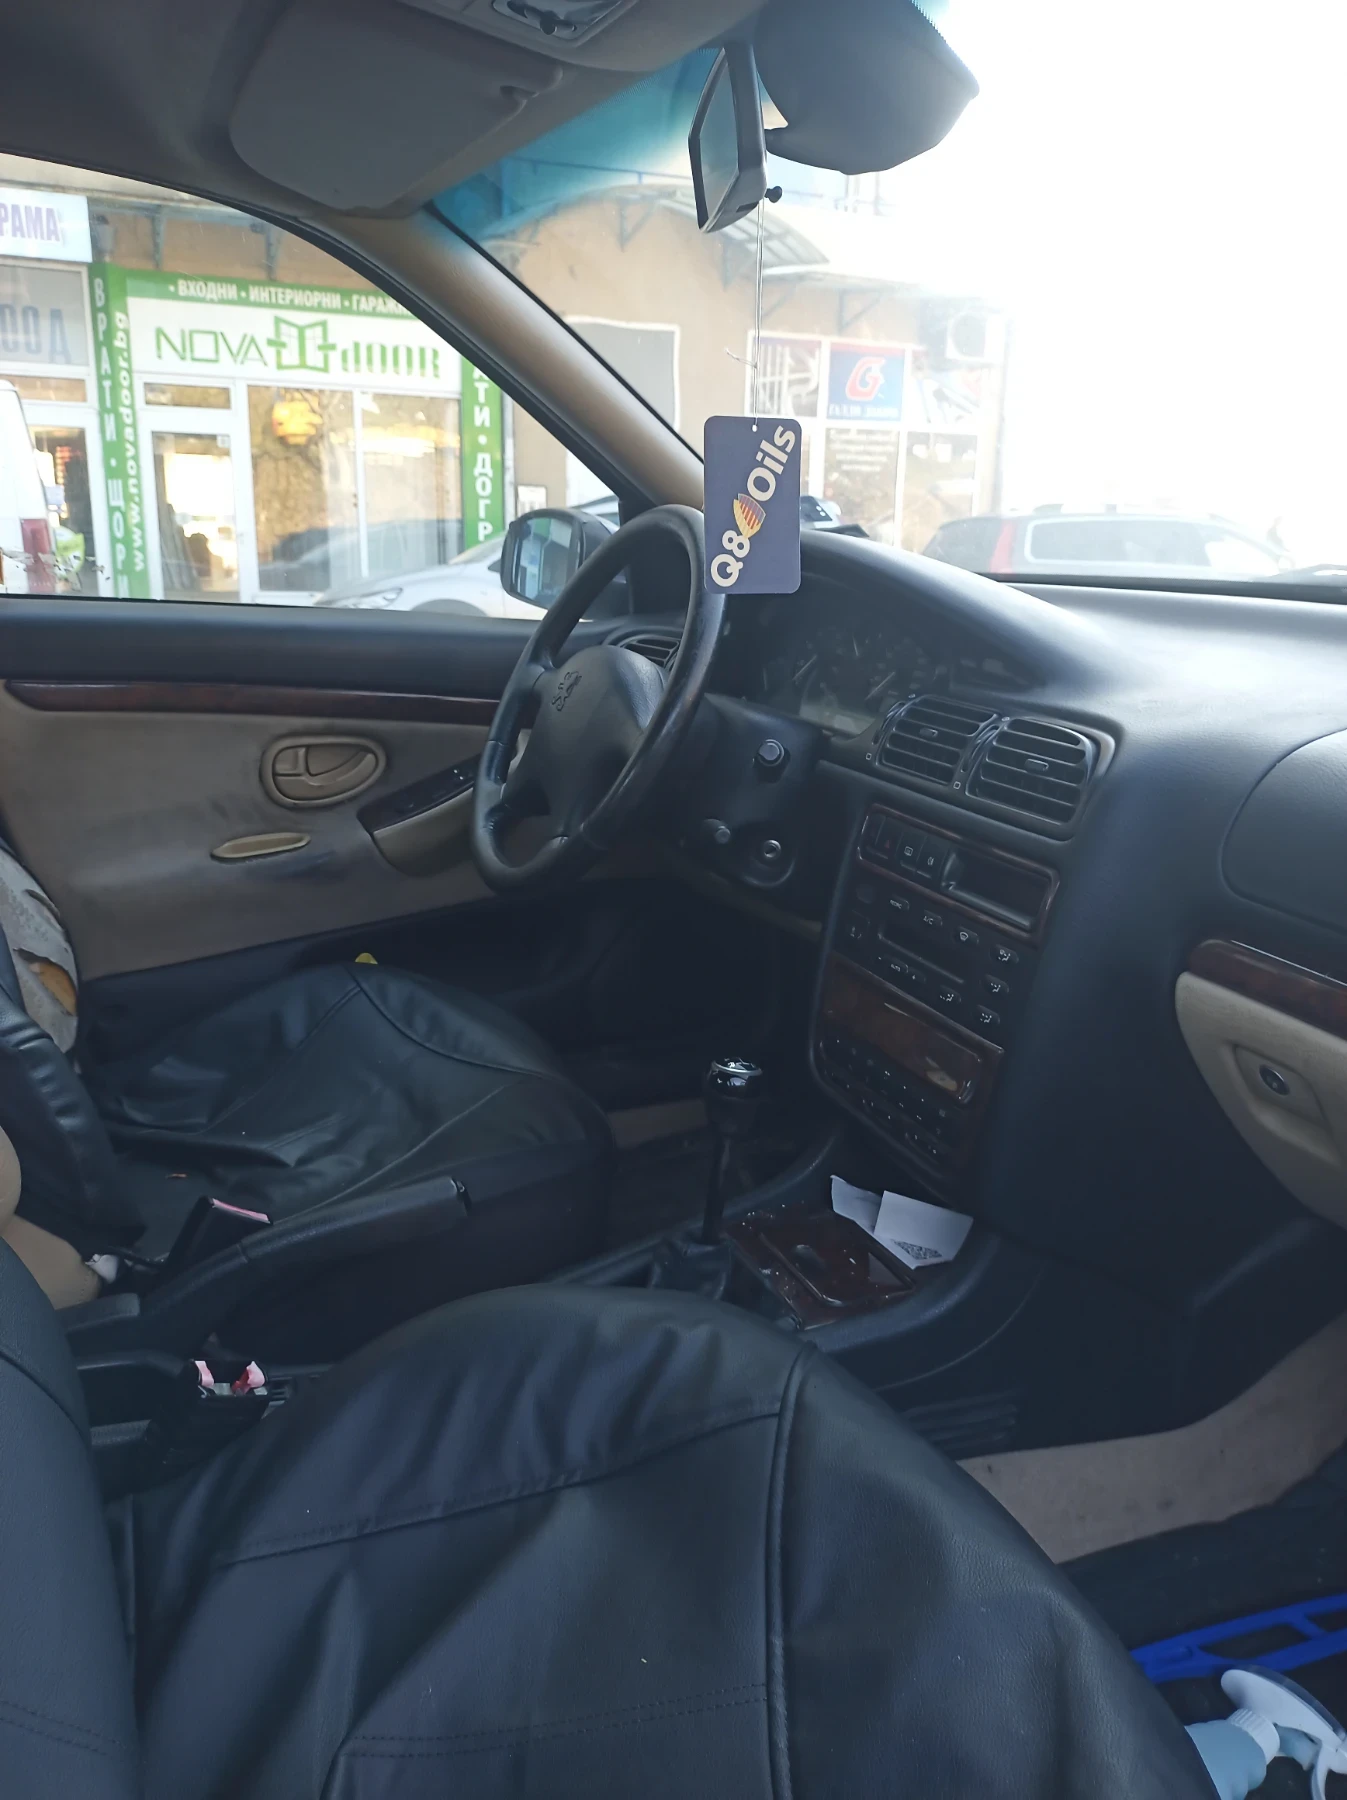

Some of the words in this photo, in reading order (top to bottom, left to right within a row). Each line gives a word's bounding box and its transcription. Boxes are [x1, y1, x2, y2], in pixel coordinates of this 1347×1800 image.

[93, 278, 117, 442] ВРАТИ
[155, 327, 268, 367] NOVA
[177, 279, 238, 302] ВХОДНИ
[249, 285, 342, 309] ИНТЕРИОРНИ
[113, 312, 146, 572] www.novadoor.bg
[711, 530, 750, 587] Q8
[747, 425, 796, 501] Oils
